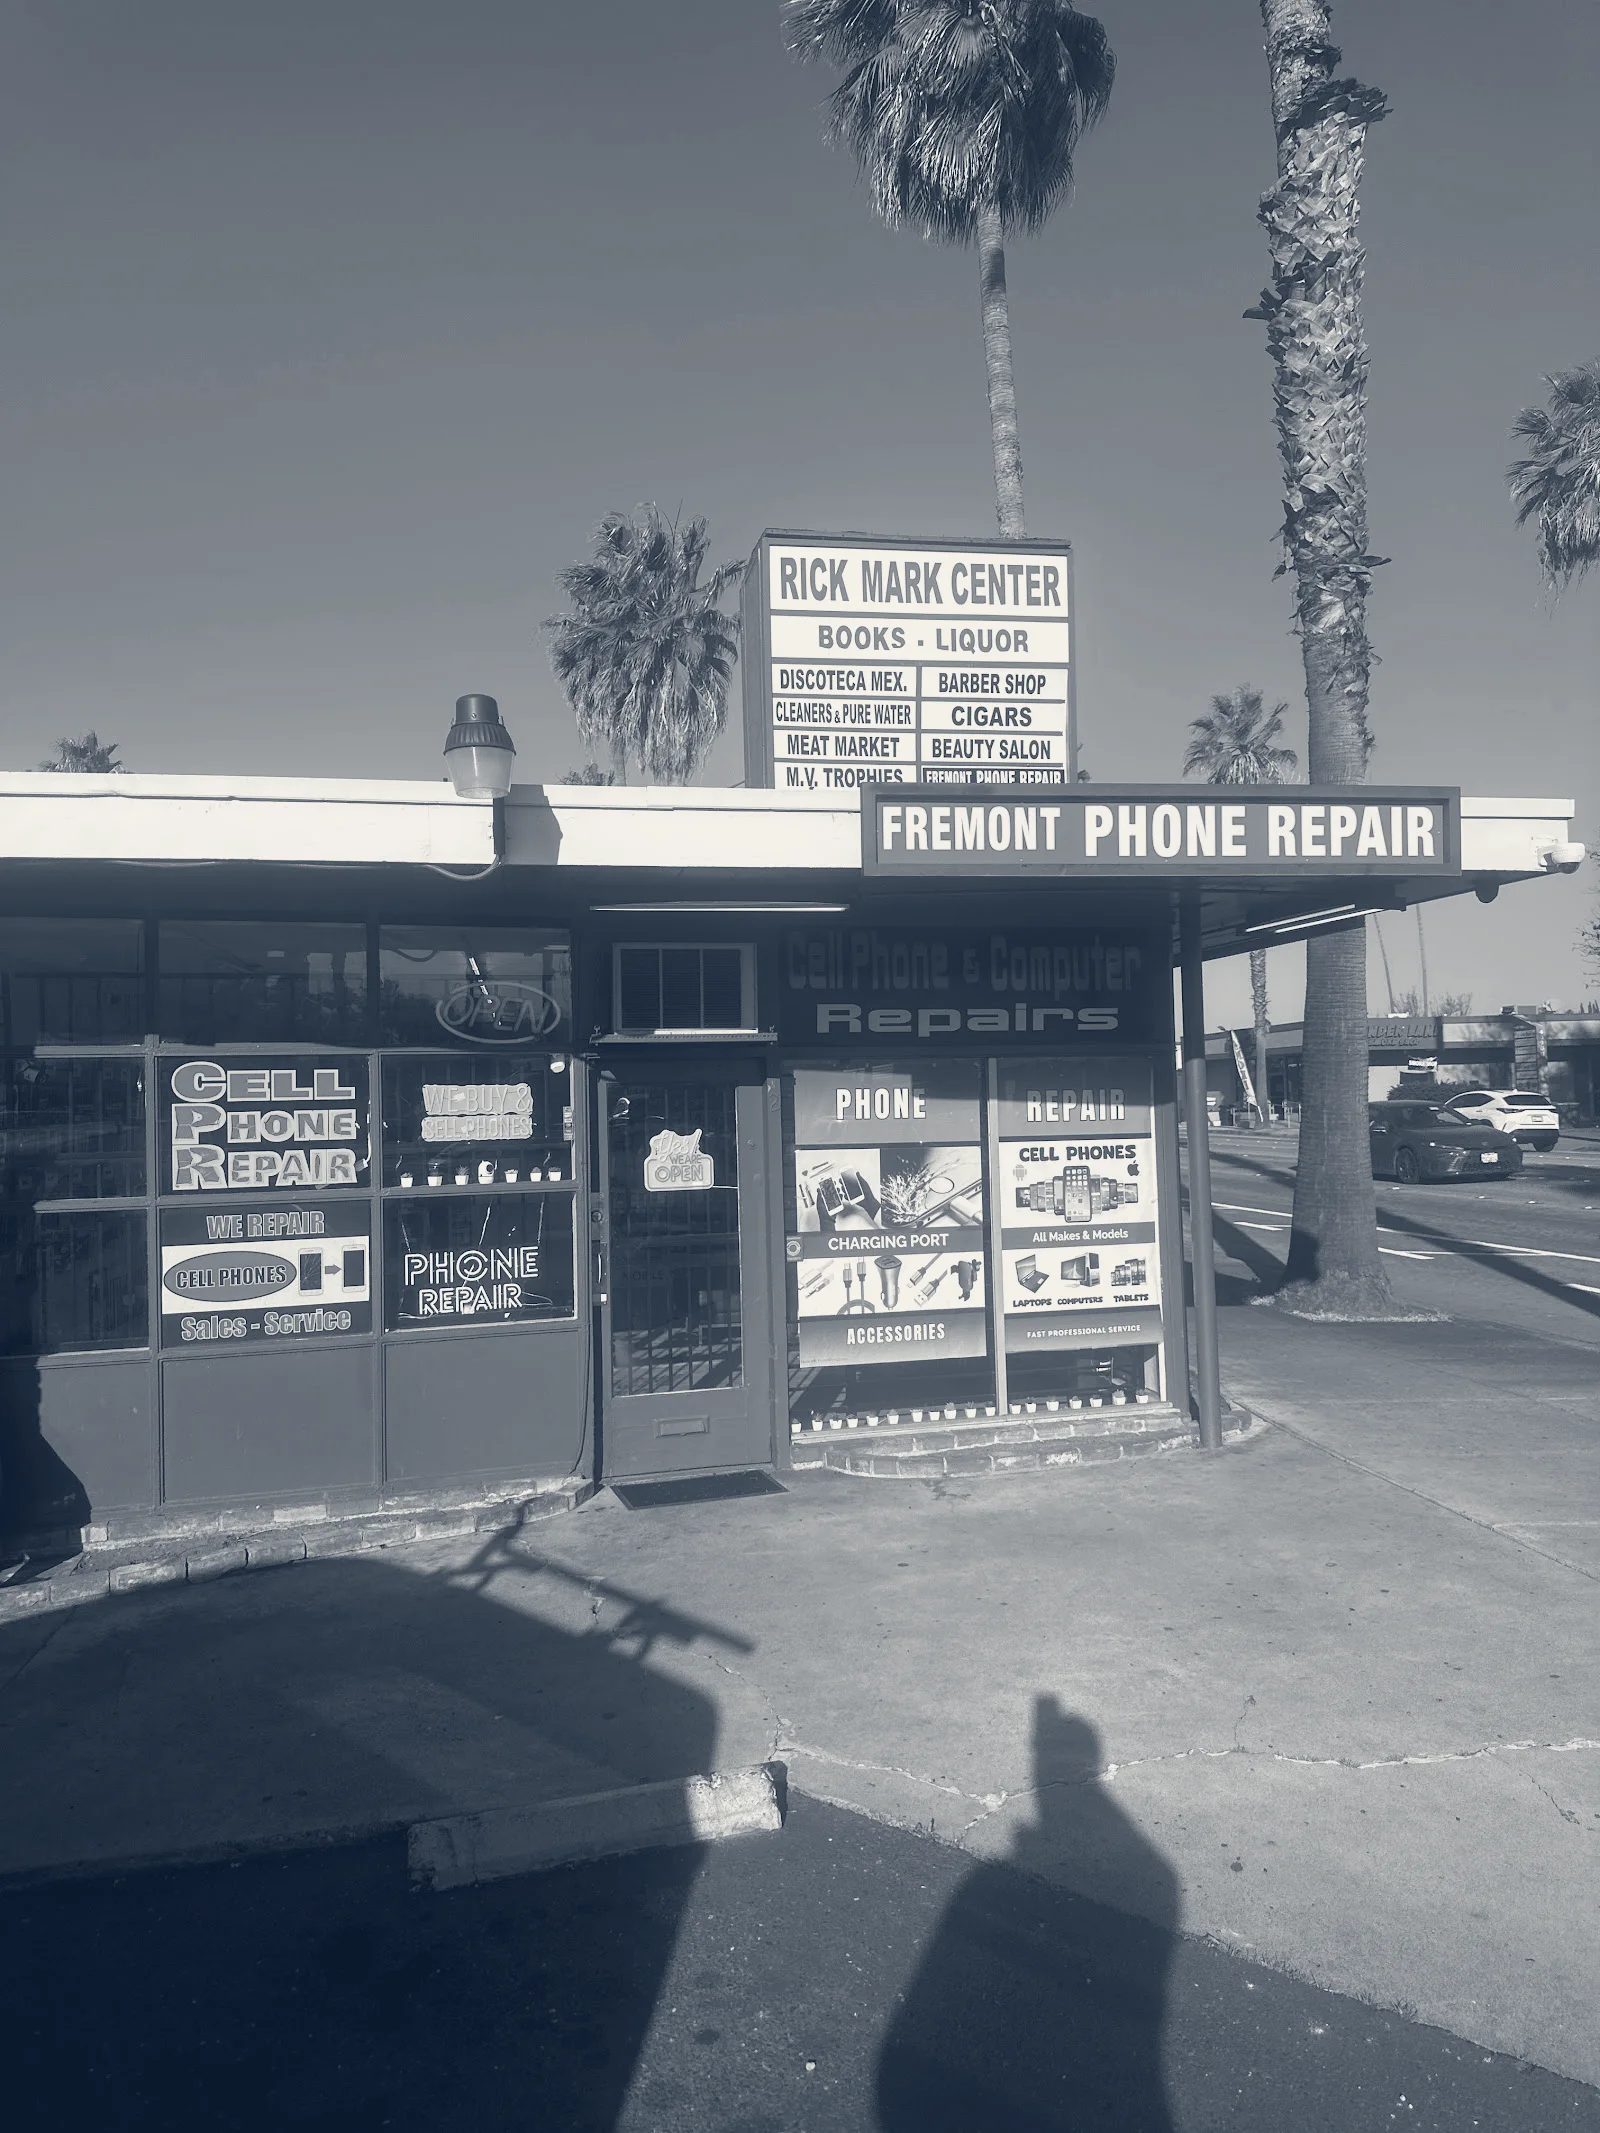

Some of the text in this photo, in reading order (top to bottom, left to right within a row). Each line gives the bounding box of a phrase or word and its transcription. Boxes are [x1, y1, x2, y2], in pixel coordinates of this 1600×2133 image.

[780, 557, 1061, 607] RICK MARK CENTER
[818, 625, 905, 650] BOOKS
[936, 628, 1029, 654] LIQUOR
[780, 669, 907, 692] DISCOTECA MEX.
[938, 673, 1046, 695] BARBER SHOP
[776, 701, 911, 725] CLEANERS & PURE WATER
[951, 706, 1032, 728] CIGARS
[787, 734, 900, 758] MEAT MARKET
[932, 738, 1050, 761] BEAUTY SALON
[786, 767, 903, 788] M.V. TROPHIES
[926, 770, 1062, 784] FREMONT PHONE REPAIR
[881, 805, 1436, 858] FREMONT PHONE REPAIR
[788, 930, 1142, 1002] Cell Phone & Computer
[442, 991, 552, 1034] OPEN
[815, 1003, 1119, 1038] Repairs
[171, 1061, 355, 1102] CELL
[424, 1084, 532, 1114] WE BUY &
[835, 1087, 928, 1121] PHONE
[1026, 1088, 1126, 1122] REPAIR
[172, 1103, 357, 1144] PHONE
[423, 1116, 530, 1140] SELL PHONES
[653, 1131, 701, 1164] Yes!
[670, 1154, 702, 1165] WE ARE
[1019, 1144, 1136, 1162] CELL PHONES
[172, 1144, 358, 1190] REPAIR
[655, 1165, 704, 1182] OPEN
[206, 1210, 325, 1239] WE REPAIR
[1032, 1228, 1128, 1243] All Makes & Models
[828, 1233, 949, 1251] CHARGING PORT
[175, 1265, 287, 1289] CELL PHONES
[404, 1246, 539, 1287] PHONE
[418, 1283, 522, 1316] REPAIR
[1013, 1294, 1149, 1307] LAPTOPS COMPUTERS TABLETS
[181, 1315, 247, 1341] Sales
[265, 1309, 352, 1335] Service
[846, 1323, 946, 1345] ACCESSORIES
[1027, 1324, 1141, 1339] FAST PROFESSIONAL SERVICE
